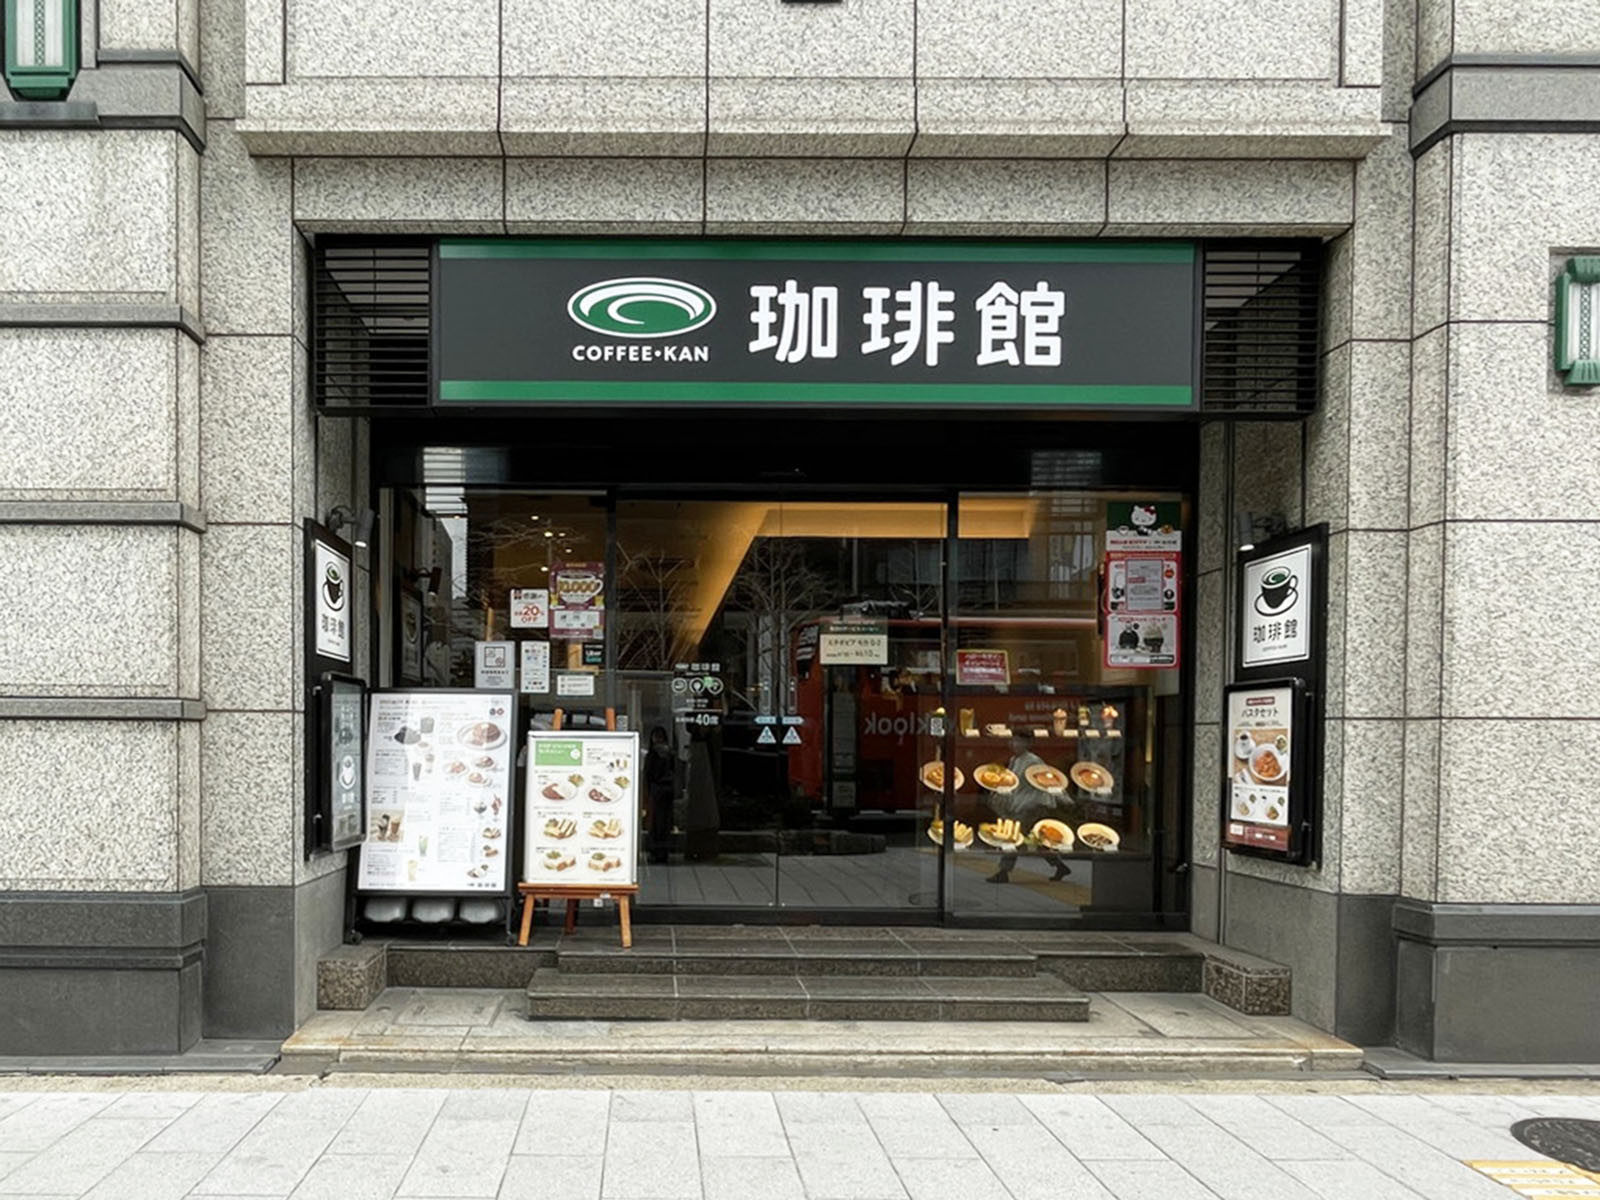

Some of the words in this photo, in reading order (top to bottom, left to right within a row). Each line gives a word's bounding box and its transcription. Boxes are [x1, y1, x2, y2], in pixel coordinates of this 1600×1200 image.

[749, 280, 1066, 367] 珈琲館
[1253, 618, 1298, 643] 珈琲館
